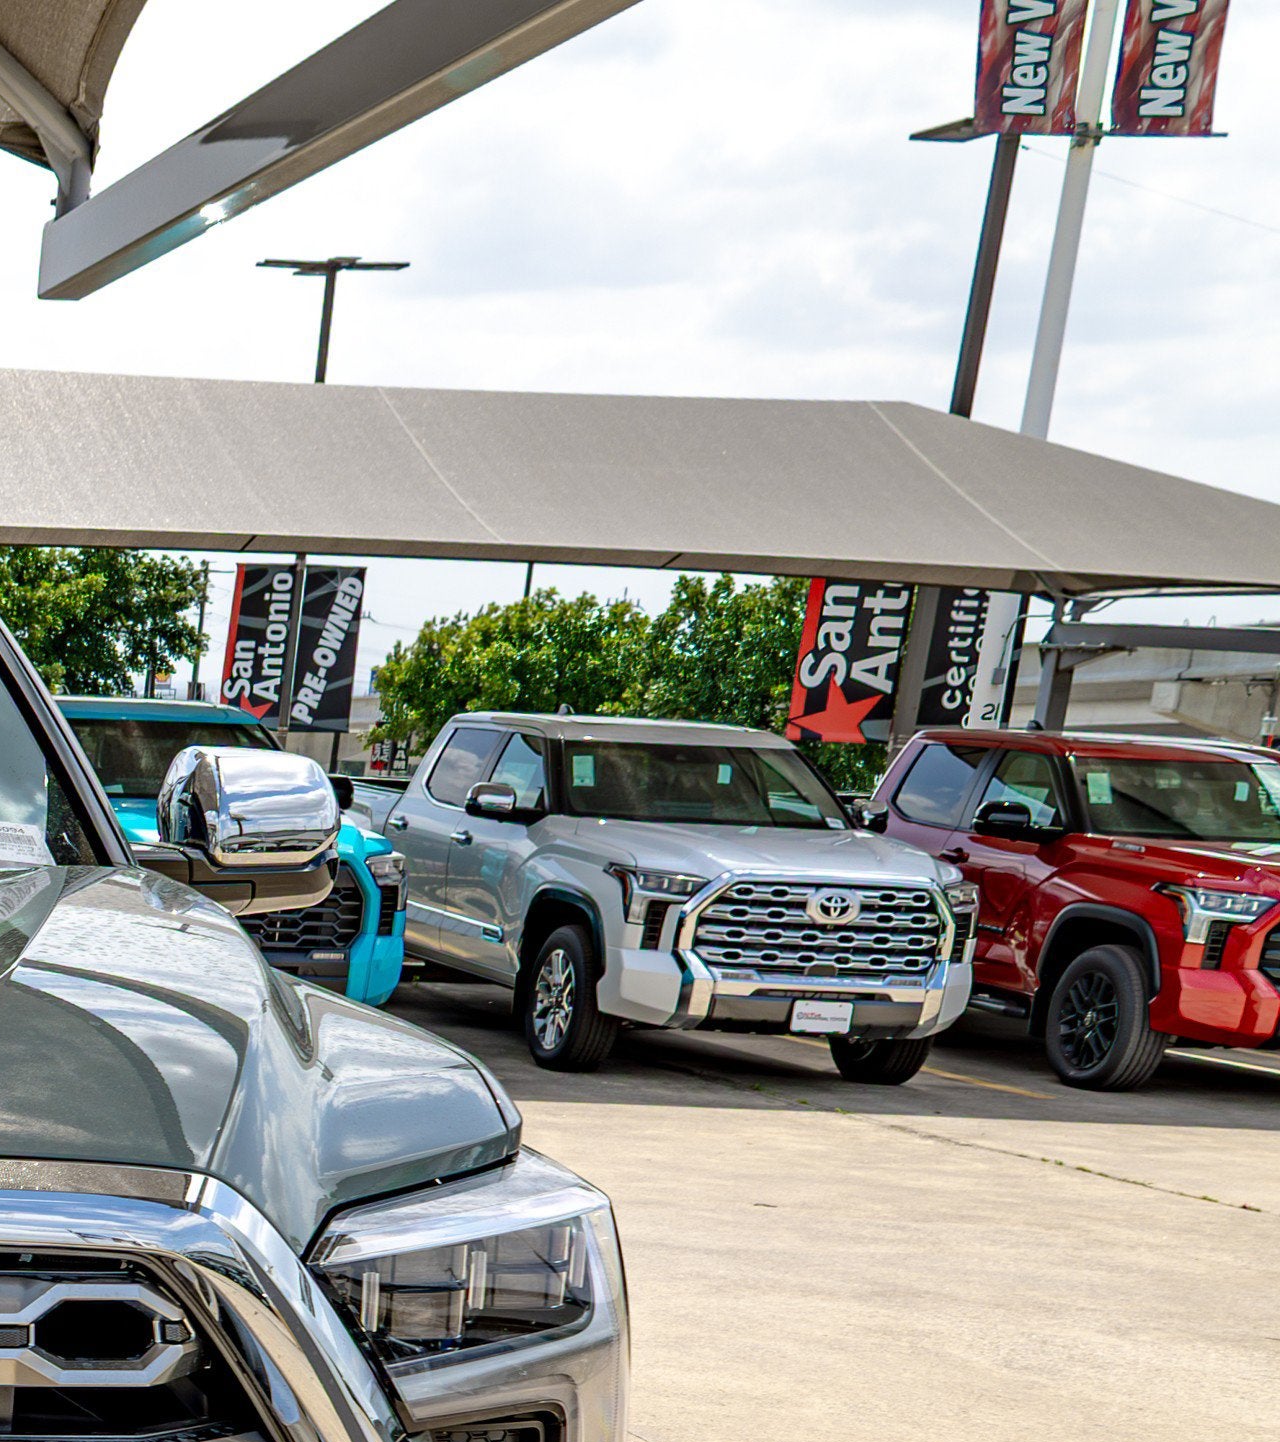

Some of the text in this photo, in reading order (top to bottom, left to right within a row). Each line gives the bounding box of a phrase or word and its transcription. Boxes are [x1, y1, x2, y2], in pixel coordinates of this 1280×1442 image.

[1002, 31, 1053, 115] New
[1139, 30, 1194, 116] New
[223, 640, 256, 700] San
[253, 572, 293, 703] Antonio
[291, 576, 363, 725] PRE-OWNED
[799, 584, 860, 689] San
[851, 583, 910, 695] Ant
[941, 588, 981, 710] certifi
